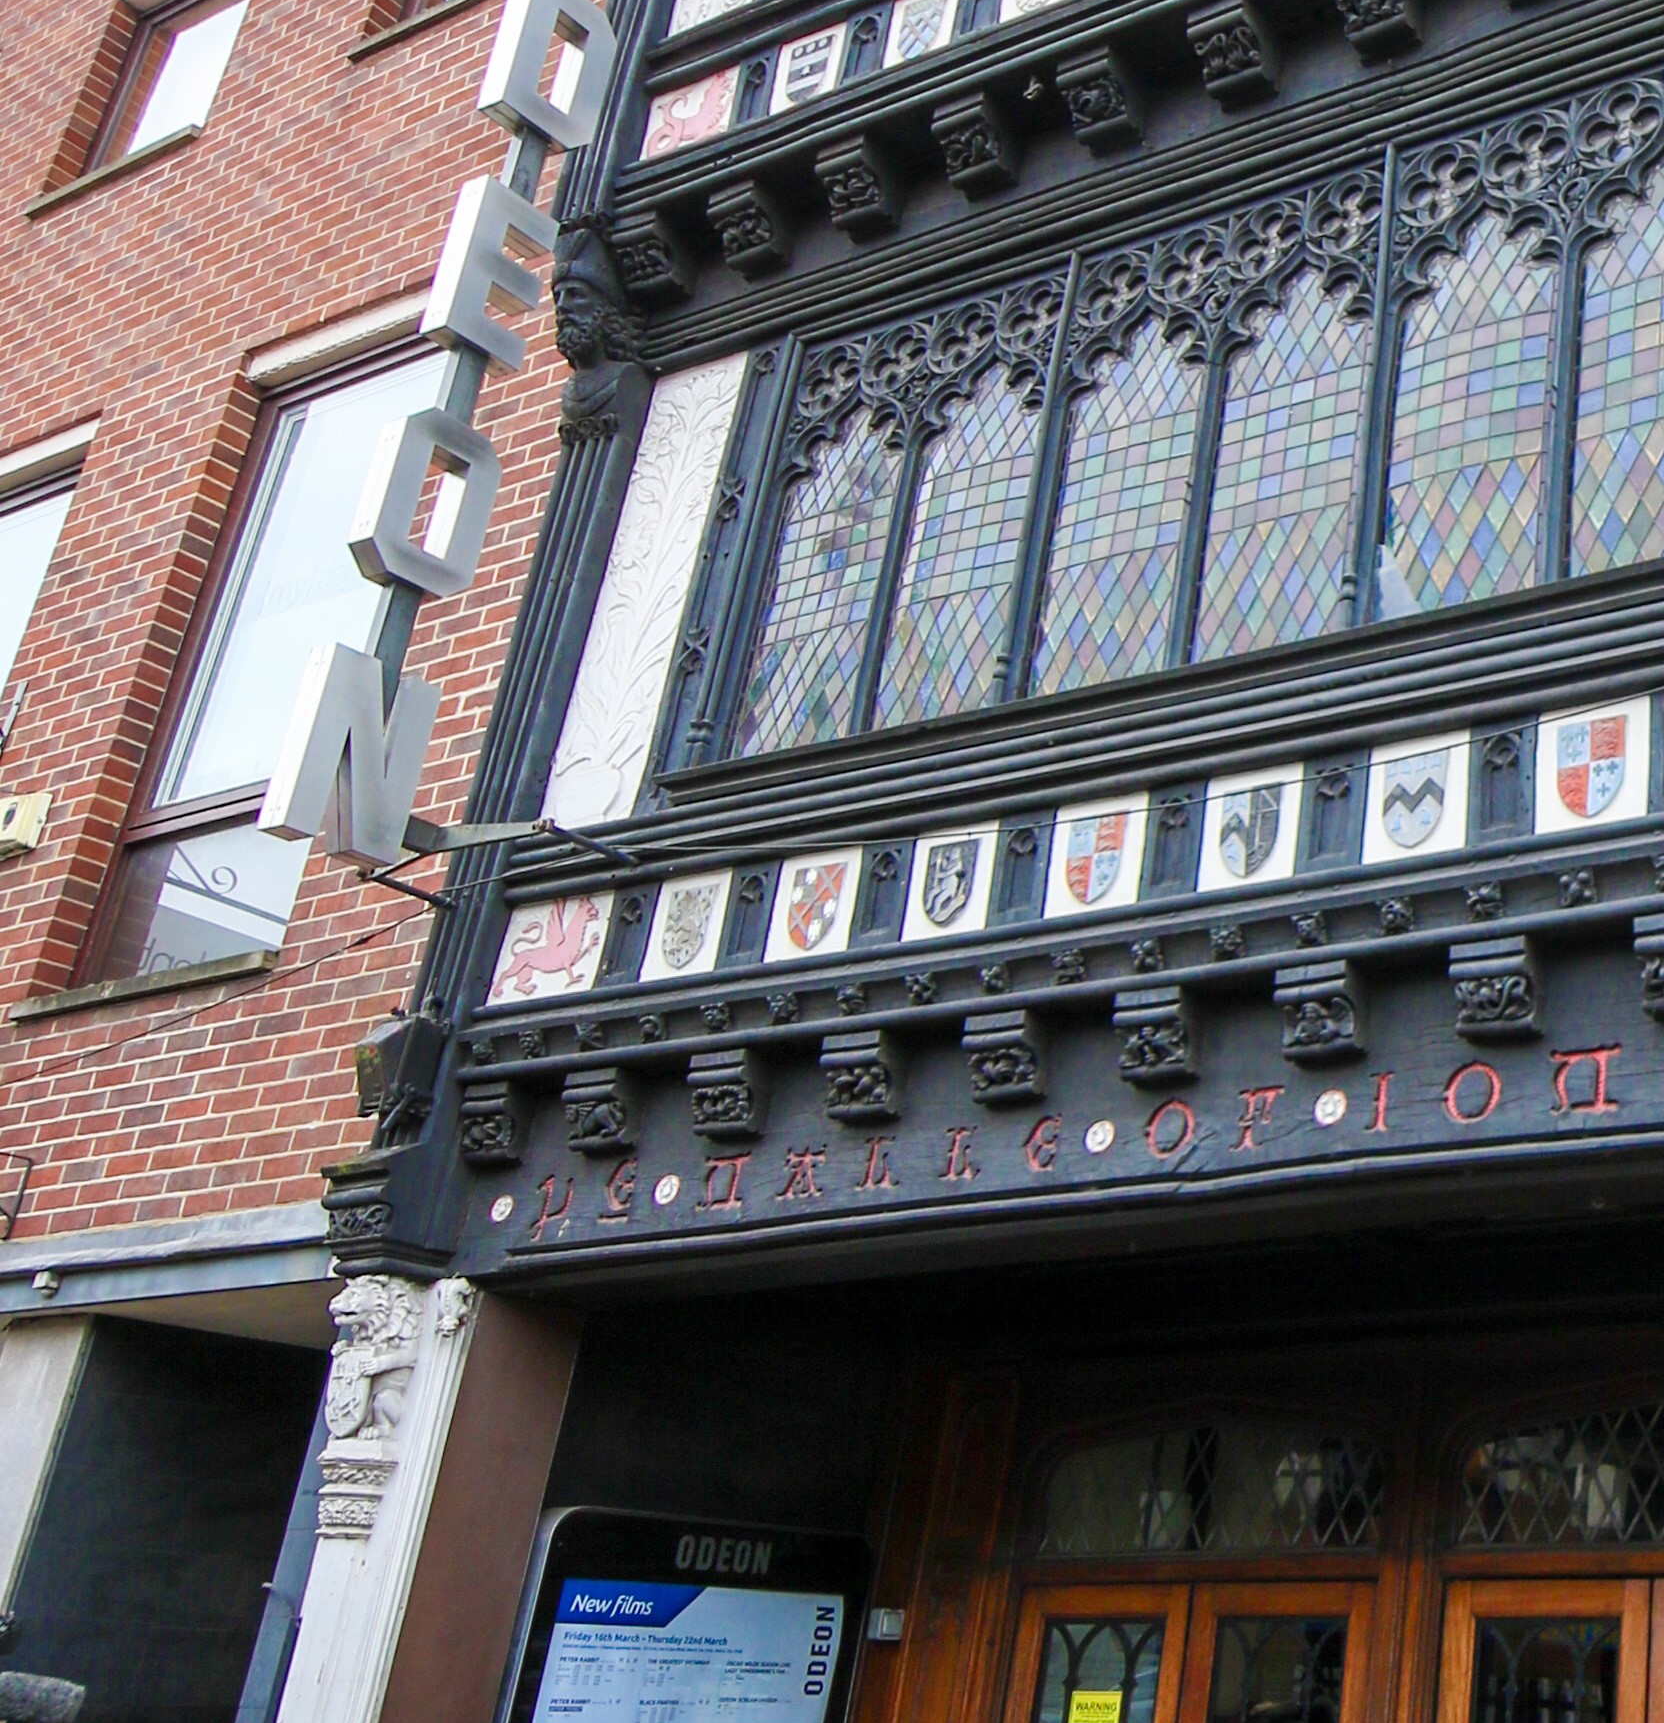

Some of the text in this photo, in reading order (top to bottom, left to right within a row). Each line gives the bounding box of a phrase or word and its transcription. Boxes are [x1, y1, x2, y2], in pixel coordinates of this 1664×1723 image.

[675, 1535, 774, 1575] ODEON
[570, 1593, 654, 1618] New films
[564, 1631, 592, 1642] Friday
[613, 1634, 640, 1643] March
[647, 1634, 683, 1646] Thursday
[684, 1636, 703, 1645] 22nd
[703, 1637, 728, 1646] March
[803, 1605, 836, 1696] ODEON
[1075, 1700, 1117, 1712] WARNING
